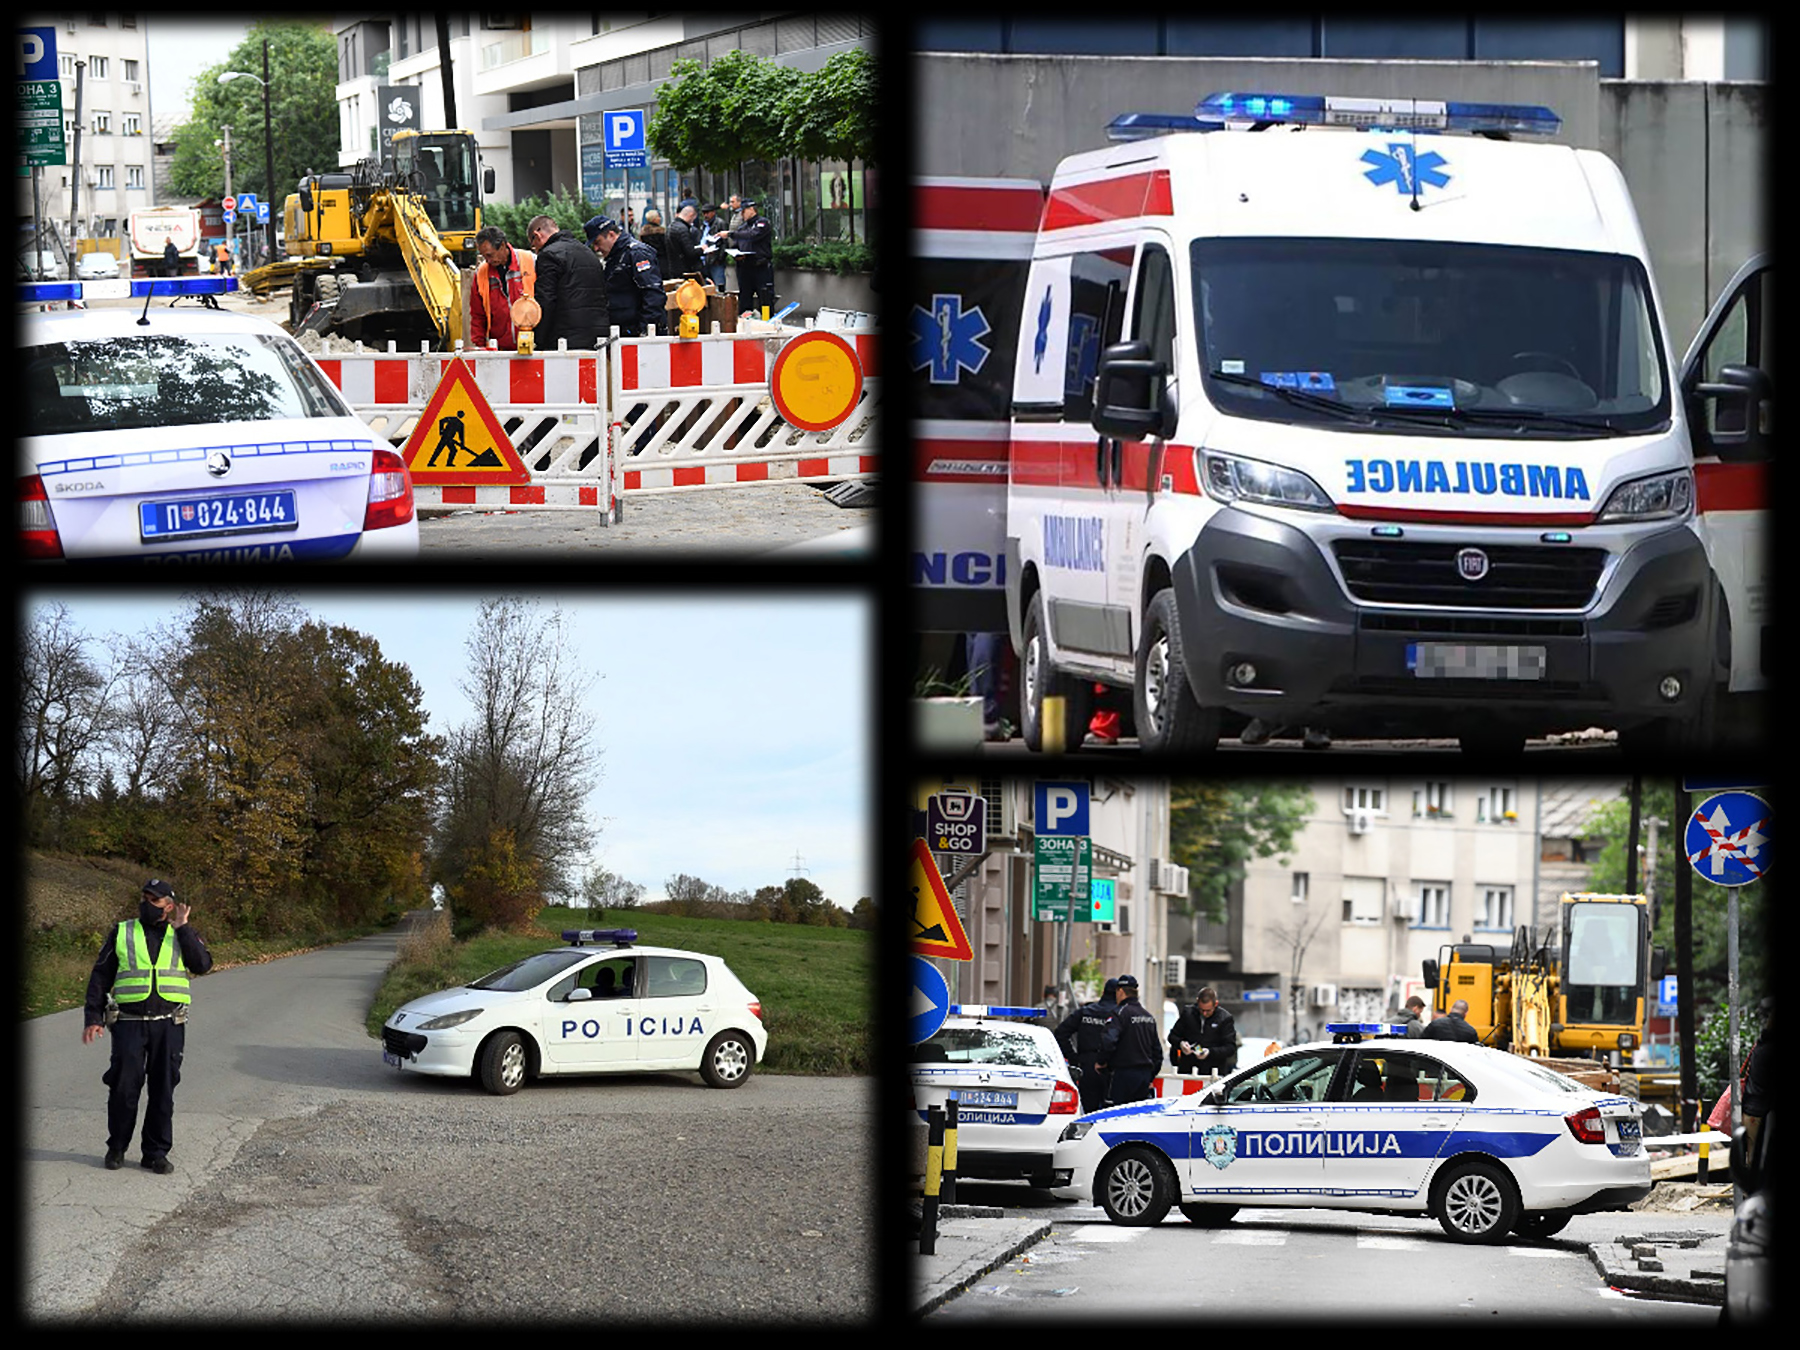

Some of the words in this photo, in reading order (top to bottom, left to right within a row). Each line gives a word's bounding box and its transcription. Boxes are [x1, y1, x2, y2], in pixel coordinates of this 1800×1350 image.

[16, 34, 44, 75] P
[17, 84, 45, 95] ОНА
[49, 83, 57, 94] 3
[612, 116, 635, 147] P
[259, 205, 268, 217] P
[330, 461, 366, 472] RAPID
[1043, 514, 1105, 573] AMBULANCE
[1464, 556, 1482, 571] FIAT
[1047, 787, 1078, 830] P
[935, 822, 977, 837] SHOP
[938, 836, 973, 850] &GO
[1664, 980, 1677, 1003] P
[957, 1111, 1016, 1124] ОЛИЦИЈА
[1245, 1133, 1402, 1157] ПОЛИЦИЈА
